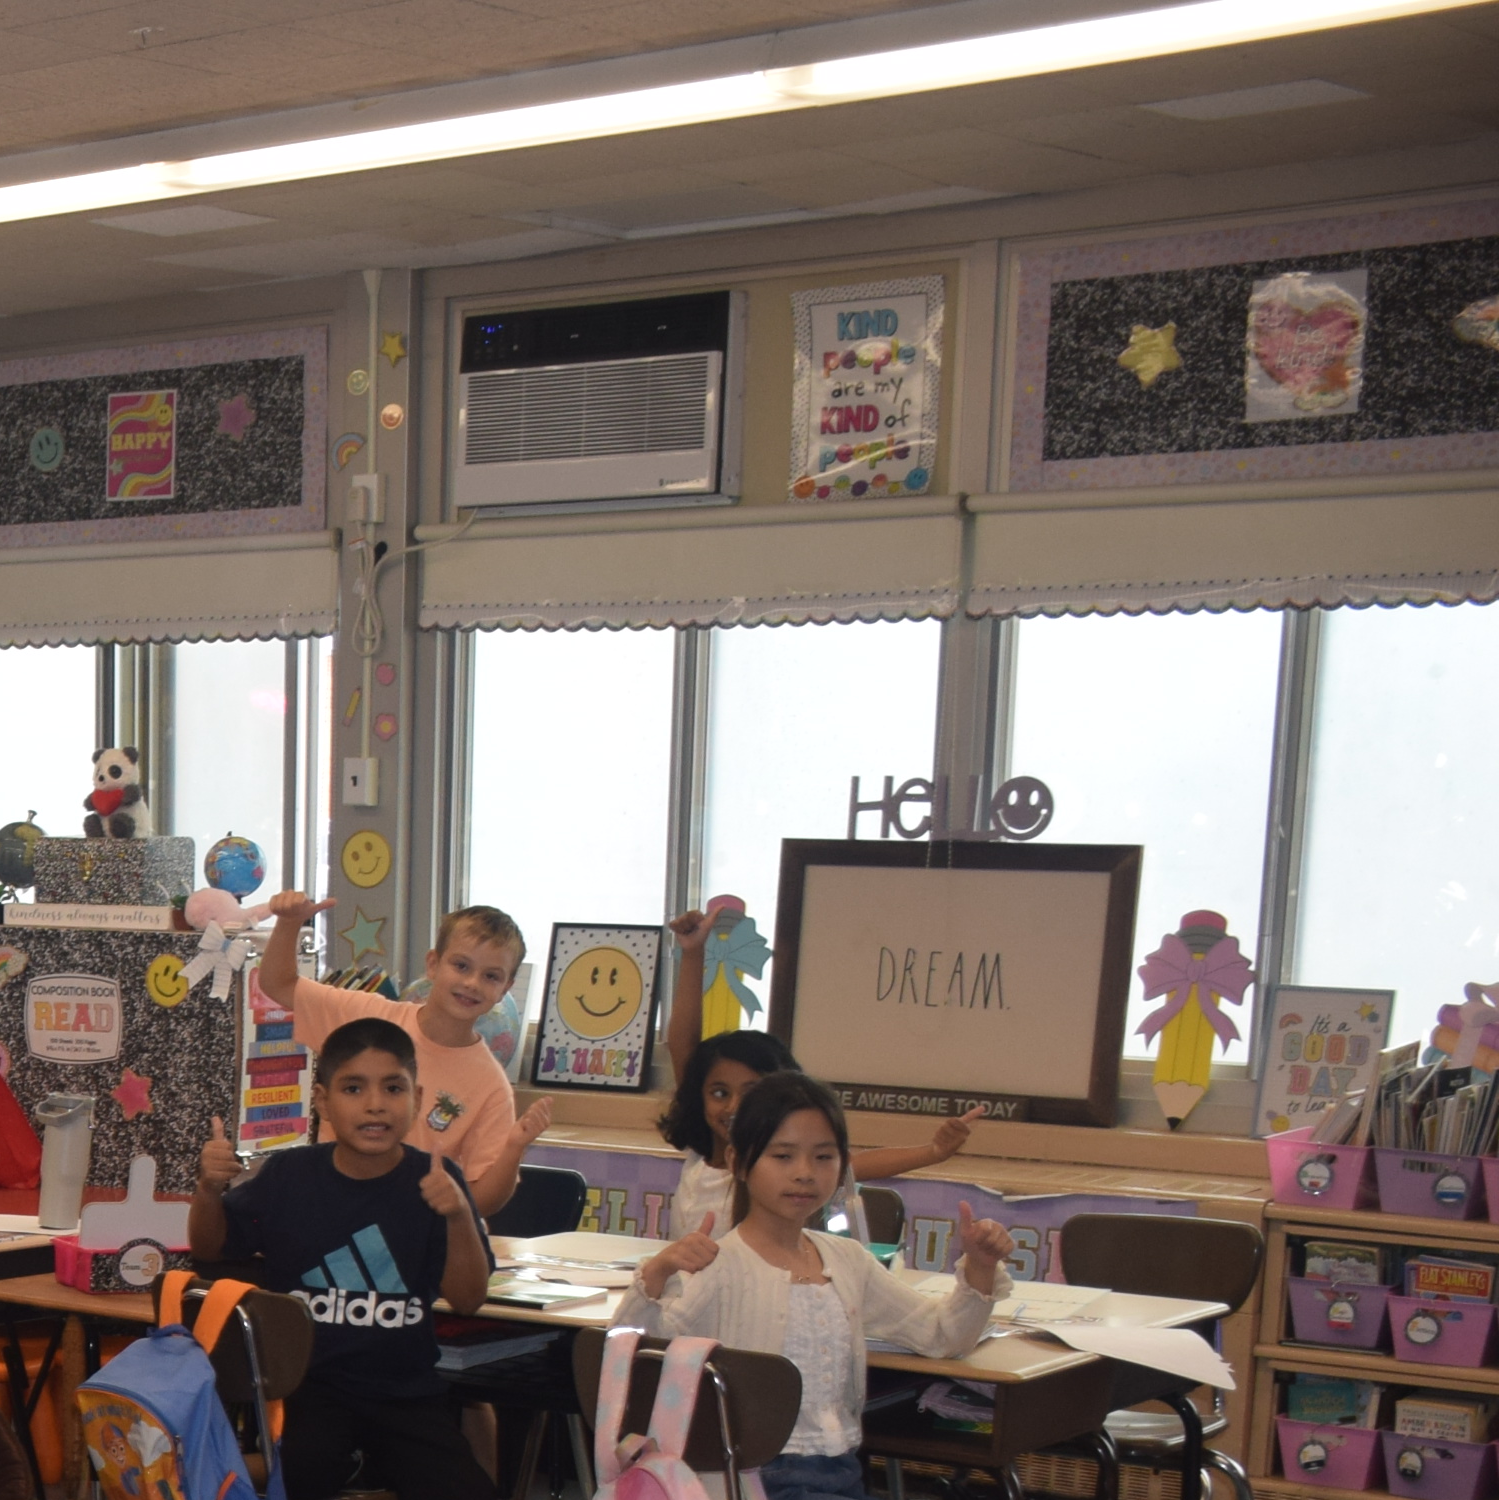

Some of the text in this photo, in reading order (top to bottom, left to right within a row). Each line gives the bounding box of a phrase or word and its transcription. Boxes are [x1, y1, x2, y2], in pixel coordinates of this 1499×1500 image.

[837, 308, 899, 342] KIND
[822, 337, 917, 379] people
[831, 377, 903, 404] are my
[820, 398, 912, 435] KIND of
[111, 431, 171, 451] HAPPY
[819, 432, 911, 473] people
[350, 775, 358, 787] 1
[8, 908, 163, 924] kindness always matters
[31, 985, 116, 998] COMPOSITION BOOK
[33, 1000, 114, 1033] READ
[1309, 1013, 1331, 1034] It's
[1281, 1031, 1370, 1066] GOOD
[571, 1047, 639, 1078] HAPPY
[1287, 1065, 1357, 1097] DAY
[251, 1089, 295, 1104] RESILIENT
[856, 1091, 949, 1115] AWESOME
[954, 1098, 1017, 1118] TODAY
[261, 1105, 291, 1119] LOVED
[121, 1252, 160, 1277] Team 3
[1419, 1265, 1440, 1285] FLAT
[288, 1287, 424, 1329] adidas
